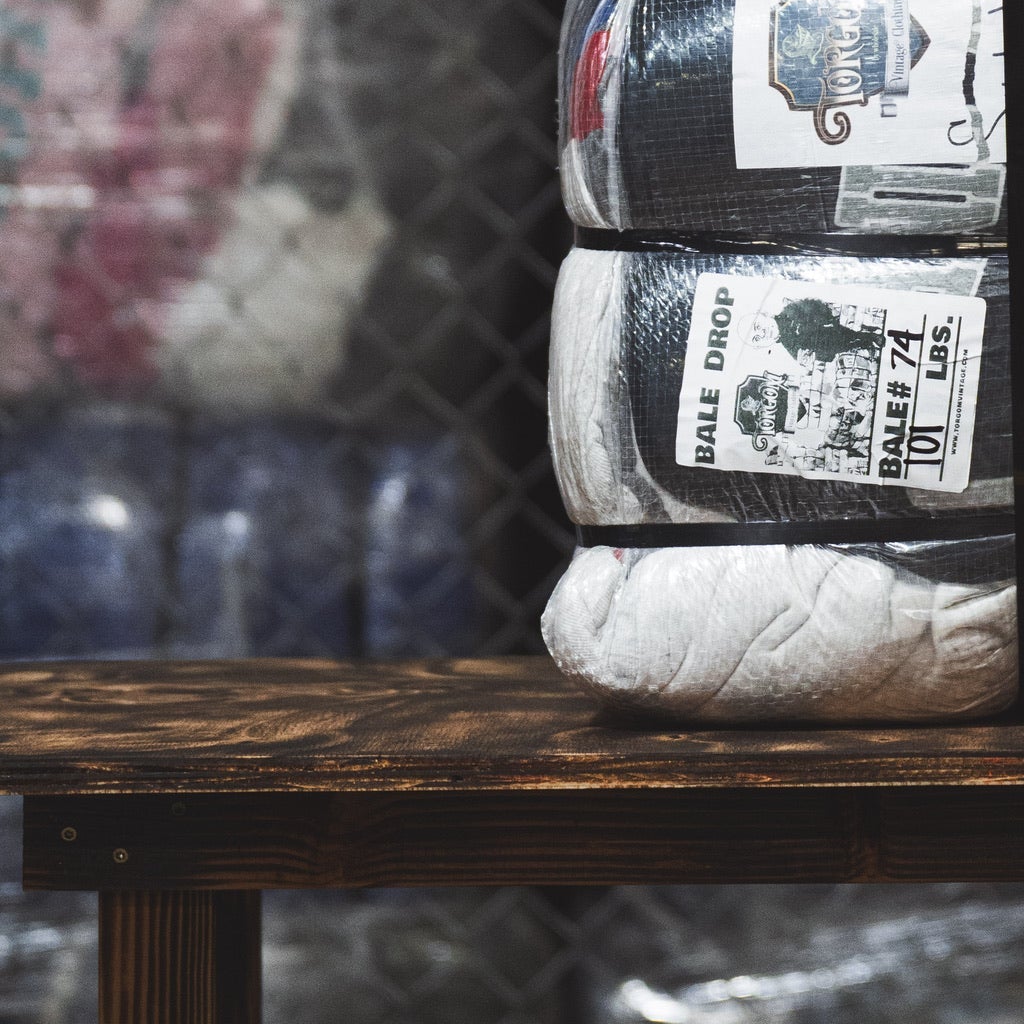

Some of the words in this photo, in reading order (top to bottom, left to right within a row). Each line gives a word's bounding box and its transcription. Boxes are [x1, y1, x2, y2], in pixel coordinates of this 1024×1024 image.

[889, 43, 907, 87] Vintage
[704, 286, 735, 372] DROP
[887, 329, 924, 370] 74
[695, 387, 721, 465] BALE
[752, 371, 790, 452] TORGOM
[878, 381, 912, 479] BALE#
[903, 426, 945, 465] 101
[925, 316, 954, 381] LBS.
[951, 348, 969, 456] WWW.TORGOMVINTAGE.COM
